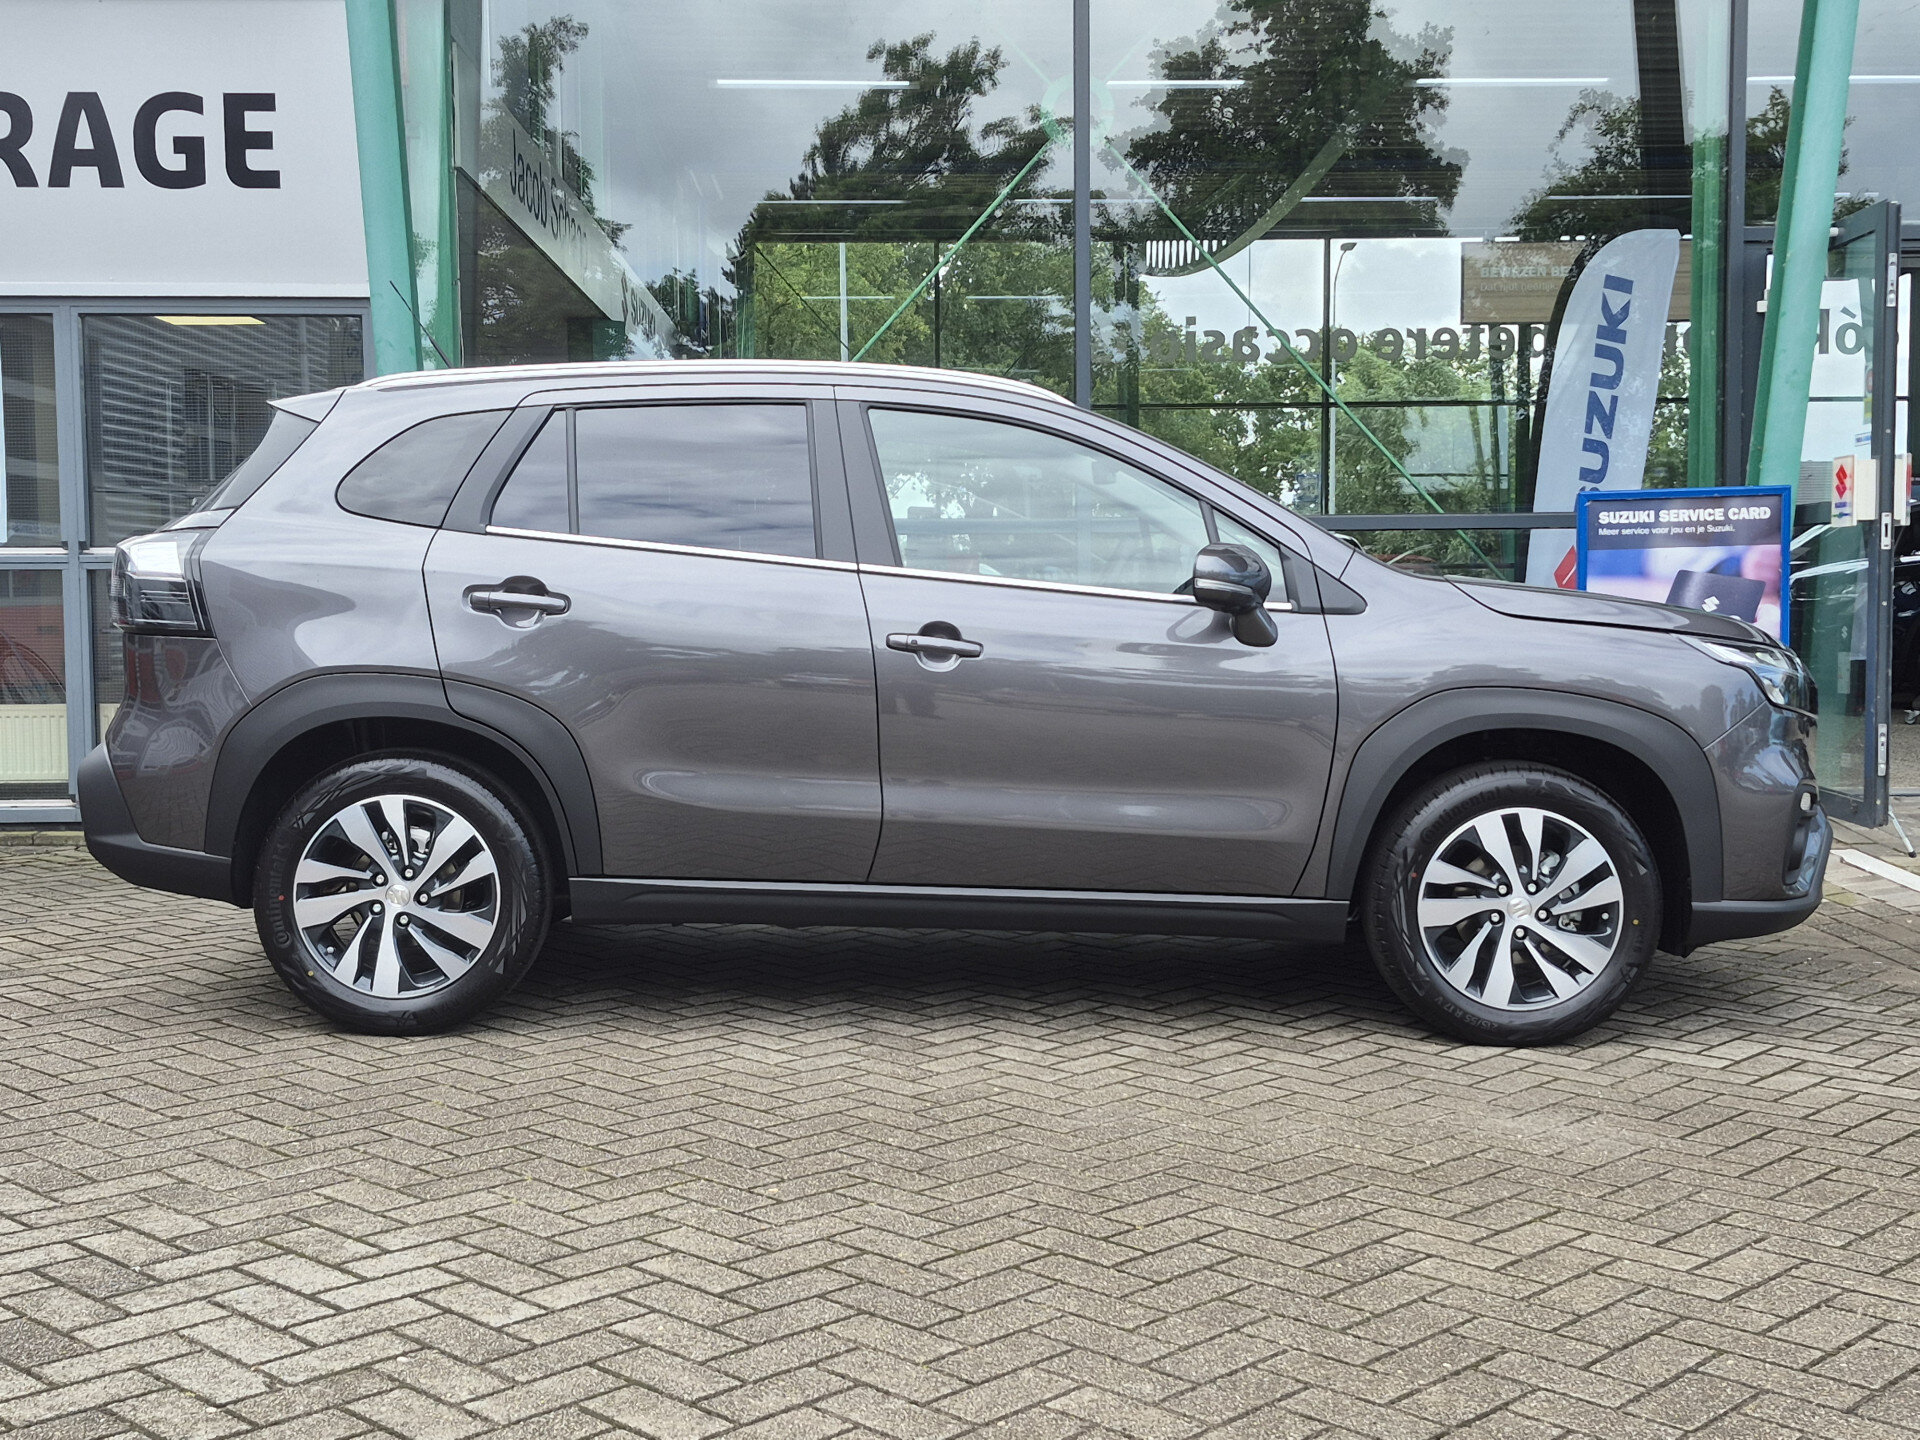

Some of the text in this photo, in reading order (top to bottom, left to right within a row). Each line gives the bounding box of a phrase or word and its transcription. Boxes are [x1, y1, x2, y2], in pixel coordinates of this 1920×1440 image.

[509, 127, 548, 228] Jacob
[1576, 274, 1635, 508] UZUKI
[1598, 506, 1771, 524] SUZUKI SERVICE CARD
[1598, 528, 1619, 536] Meer
[1621, 527, 1650, 535] service
[1670, 525, 1684, 535] jou
[1696, 525, 1706, 535] je
[1706, 524, 1736, 533] Suzuki.
